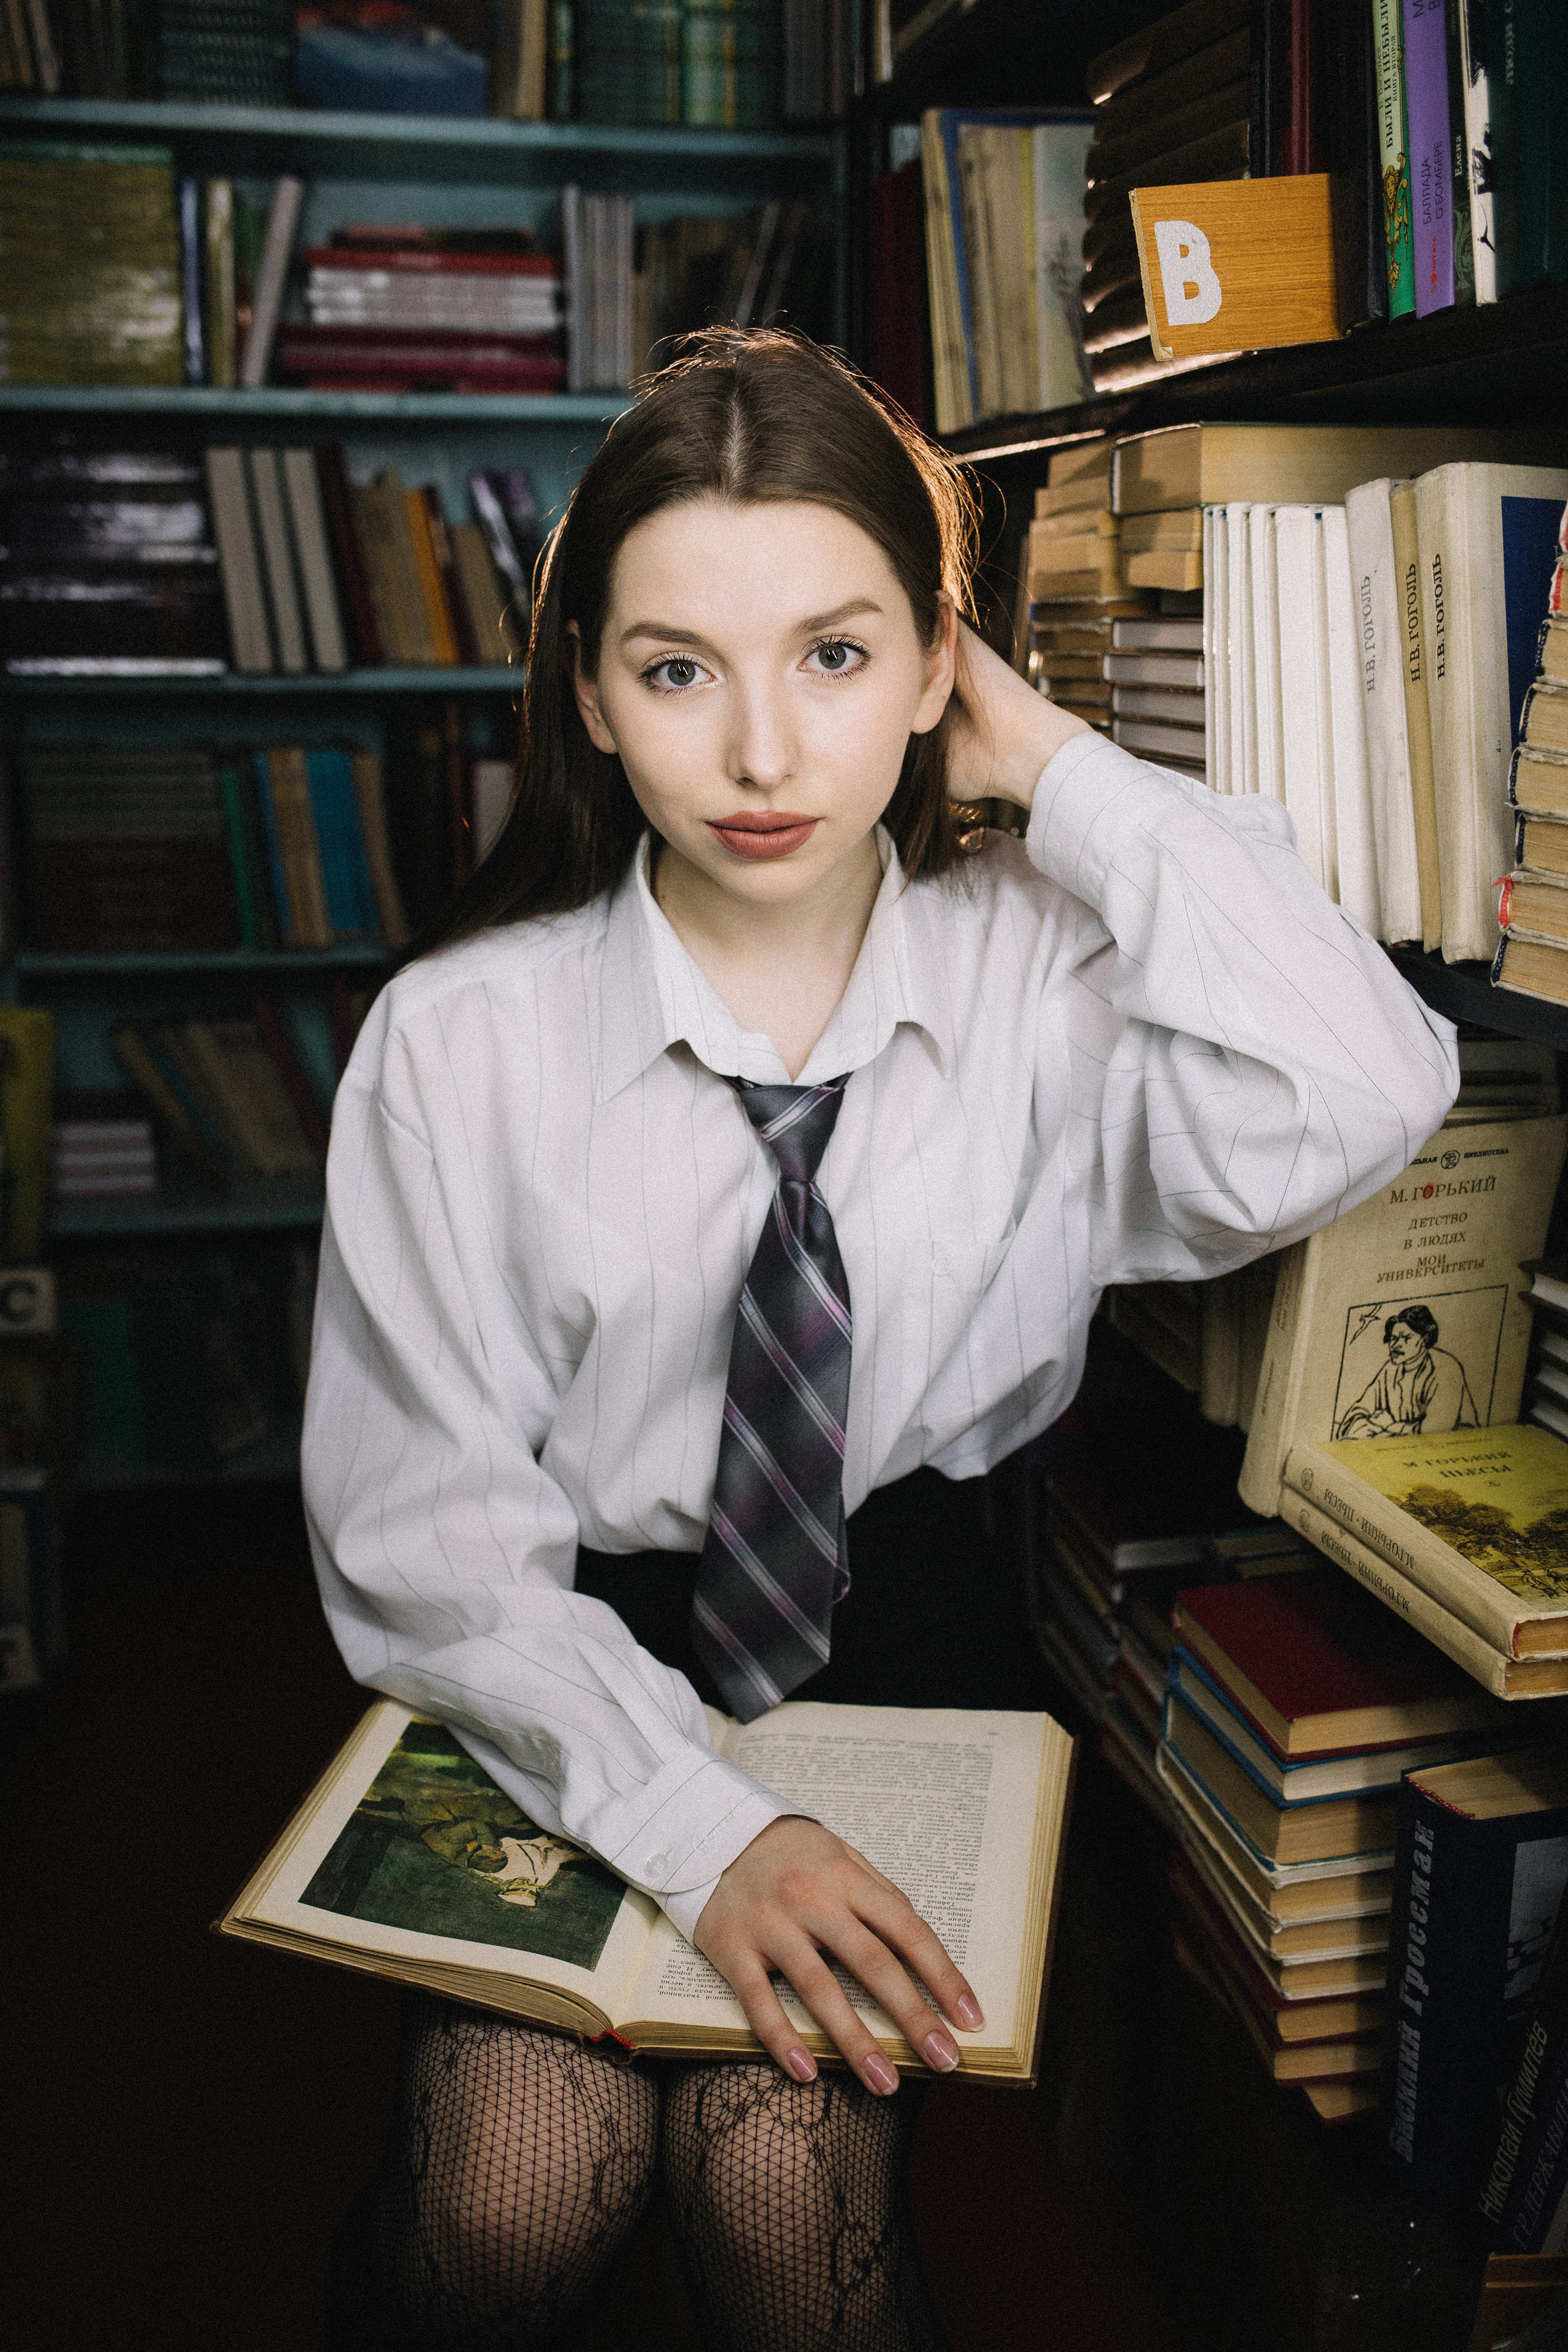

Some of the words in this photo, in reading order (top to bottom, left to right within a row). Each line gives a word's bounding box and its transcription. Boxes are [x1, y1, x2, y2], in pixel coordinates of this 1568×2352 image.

[1384, 77, 1391, 92] И
[1385, 96, 1393, 149] БЫЛИ
[1422, 156, 1432, 225] БАЛЛАДА
[1434, 141, 1444, 205] БОМБЕРЕ
[1435, 208, 1444, 219] О
[1153, 219, 1223, 327] В
[1360, 576, 1376, 651] ГОГОЛЬ
[1406, 564, 1419, 643] ГОГОЛЬ
[1432, 553, 1445, 637] ГОГОЛЬ
[1409, 644, 1421, 684] Н.В.
[1437, 638, 1446, 681] Н.В.
[1463, 1148, 1510, 1159] БИБЛИОТЕКА
[1389, 1188, 1408, 1204] М.
[1412, 1175, 1497, 1201] ГОРЬКИЙ
[1403, 1239, 1413, 1251] В
[1417, 1231, 1468, 1248] ЛЮДЯХ
[1408, 1212, 1468, 1231] ДЕТСТВО
[1376, 1258, 1485, 1284] УНИВЕРСИТЕТЫ
[1416, 1254, 1447, 1267] МОИ
[1324, 1488, 1355, 1523] ПЬЕСЫ
[1321, 1531, 1352, 1566] ПЬЕСЫ
[1399, 1820, 1435, 2016] Гроссман
[657, 1990, 701, 1999] укатанной,
[1389, 2019, 1422, 2164] Василий
[1479, 2117, 1524, 2225] Николай
